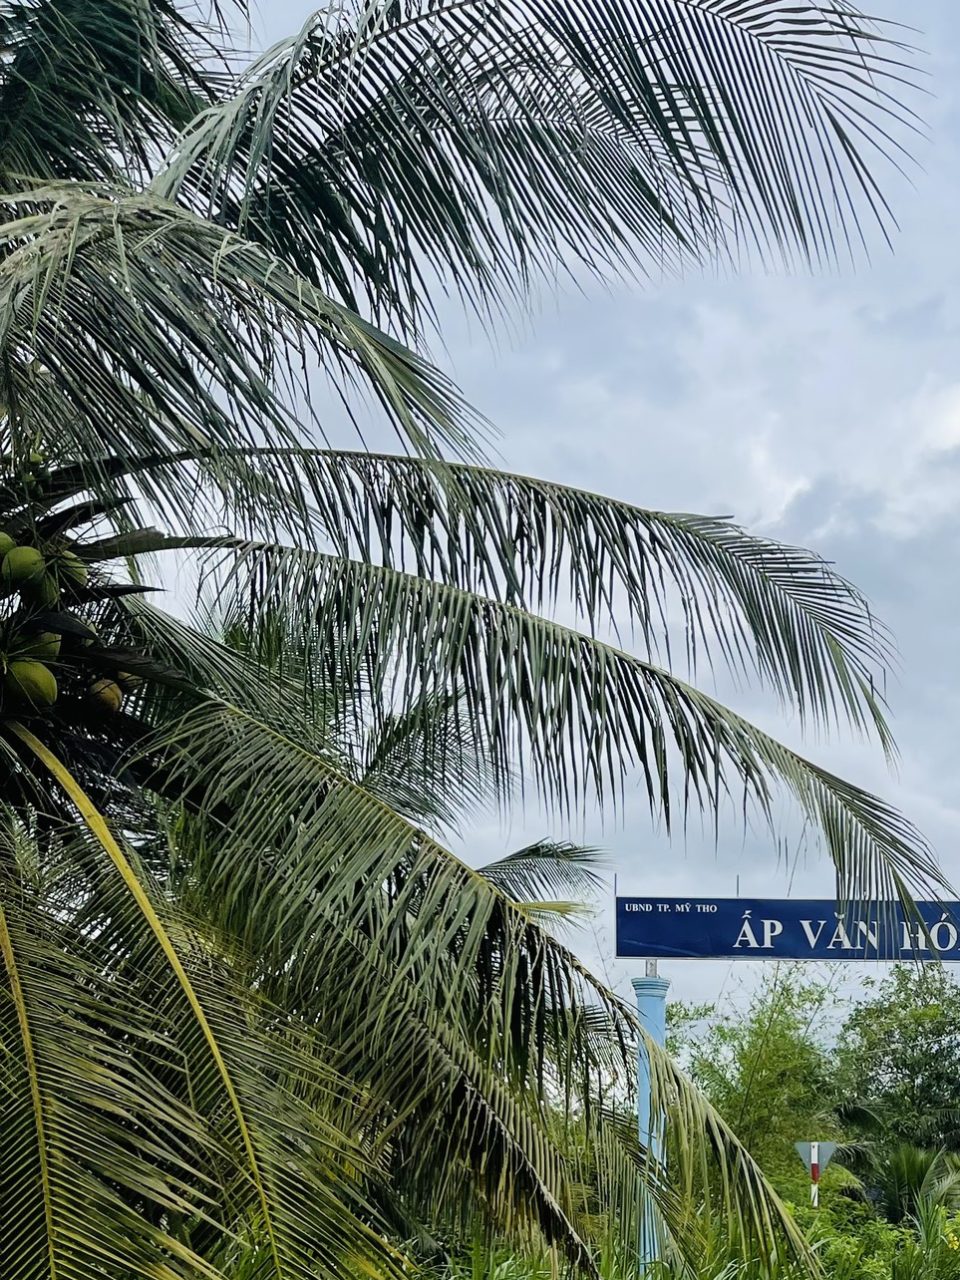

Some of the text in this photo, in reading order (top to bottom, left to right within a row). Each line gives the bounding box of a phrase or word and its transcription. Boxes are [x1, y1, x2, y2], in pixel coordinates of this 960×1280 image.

[625, 902, 717, 913] UBND TP. MỸ THO
[732, 910, 783, 949] ẤP
[799, 911, 880, 950] VĂN
